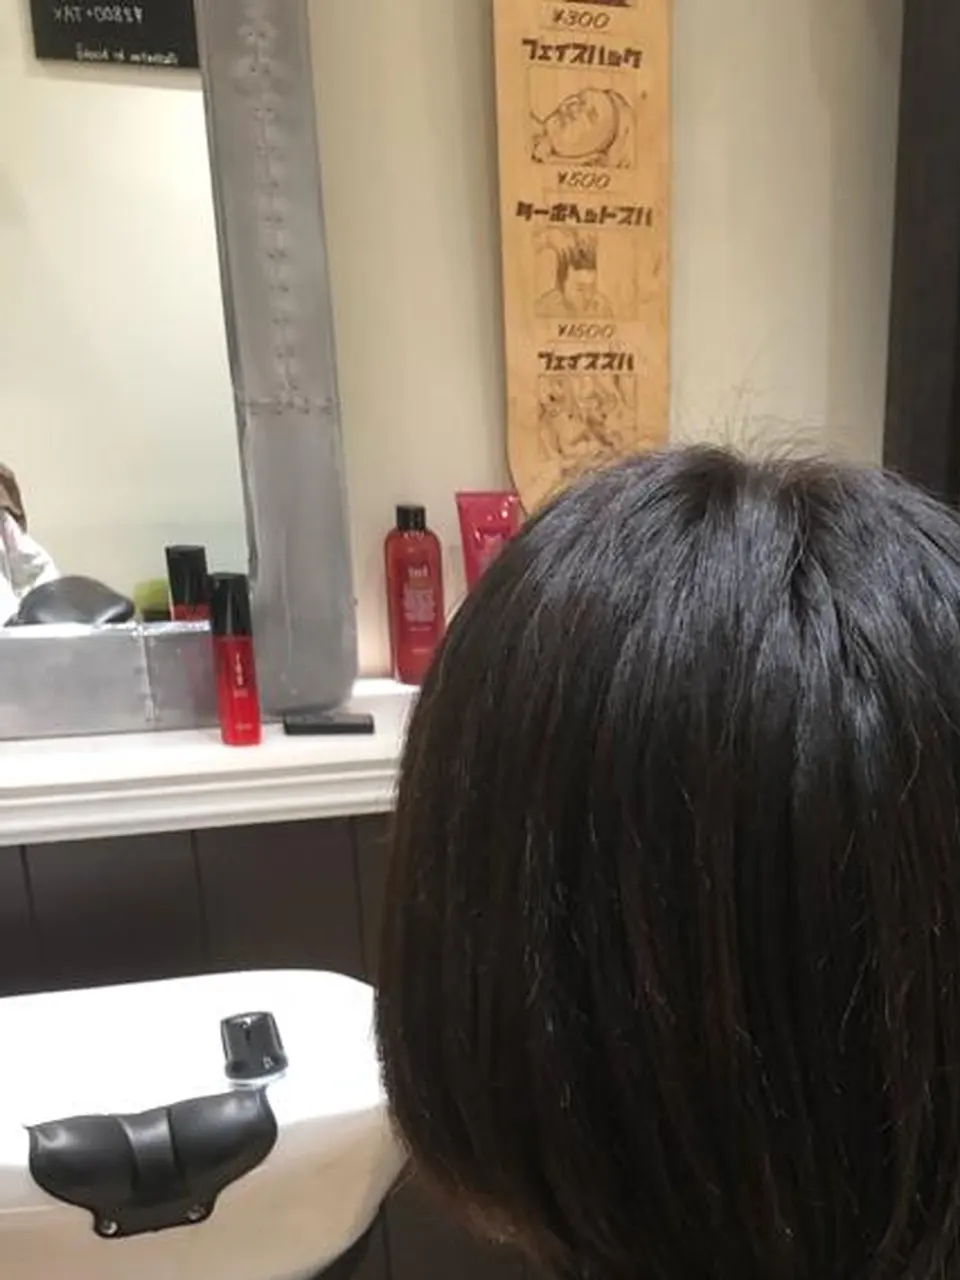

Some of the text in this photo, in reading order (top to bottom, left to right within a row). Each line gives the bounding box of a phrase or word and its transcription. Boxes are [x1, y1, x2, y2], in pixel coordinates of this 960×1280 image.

[553, 9, 610, 29] ¥300
[558, 171, 611, 189] ¥500
[558, 323, 616, 339] ¥1500
